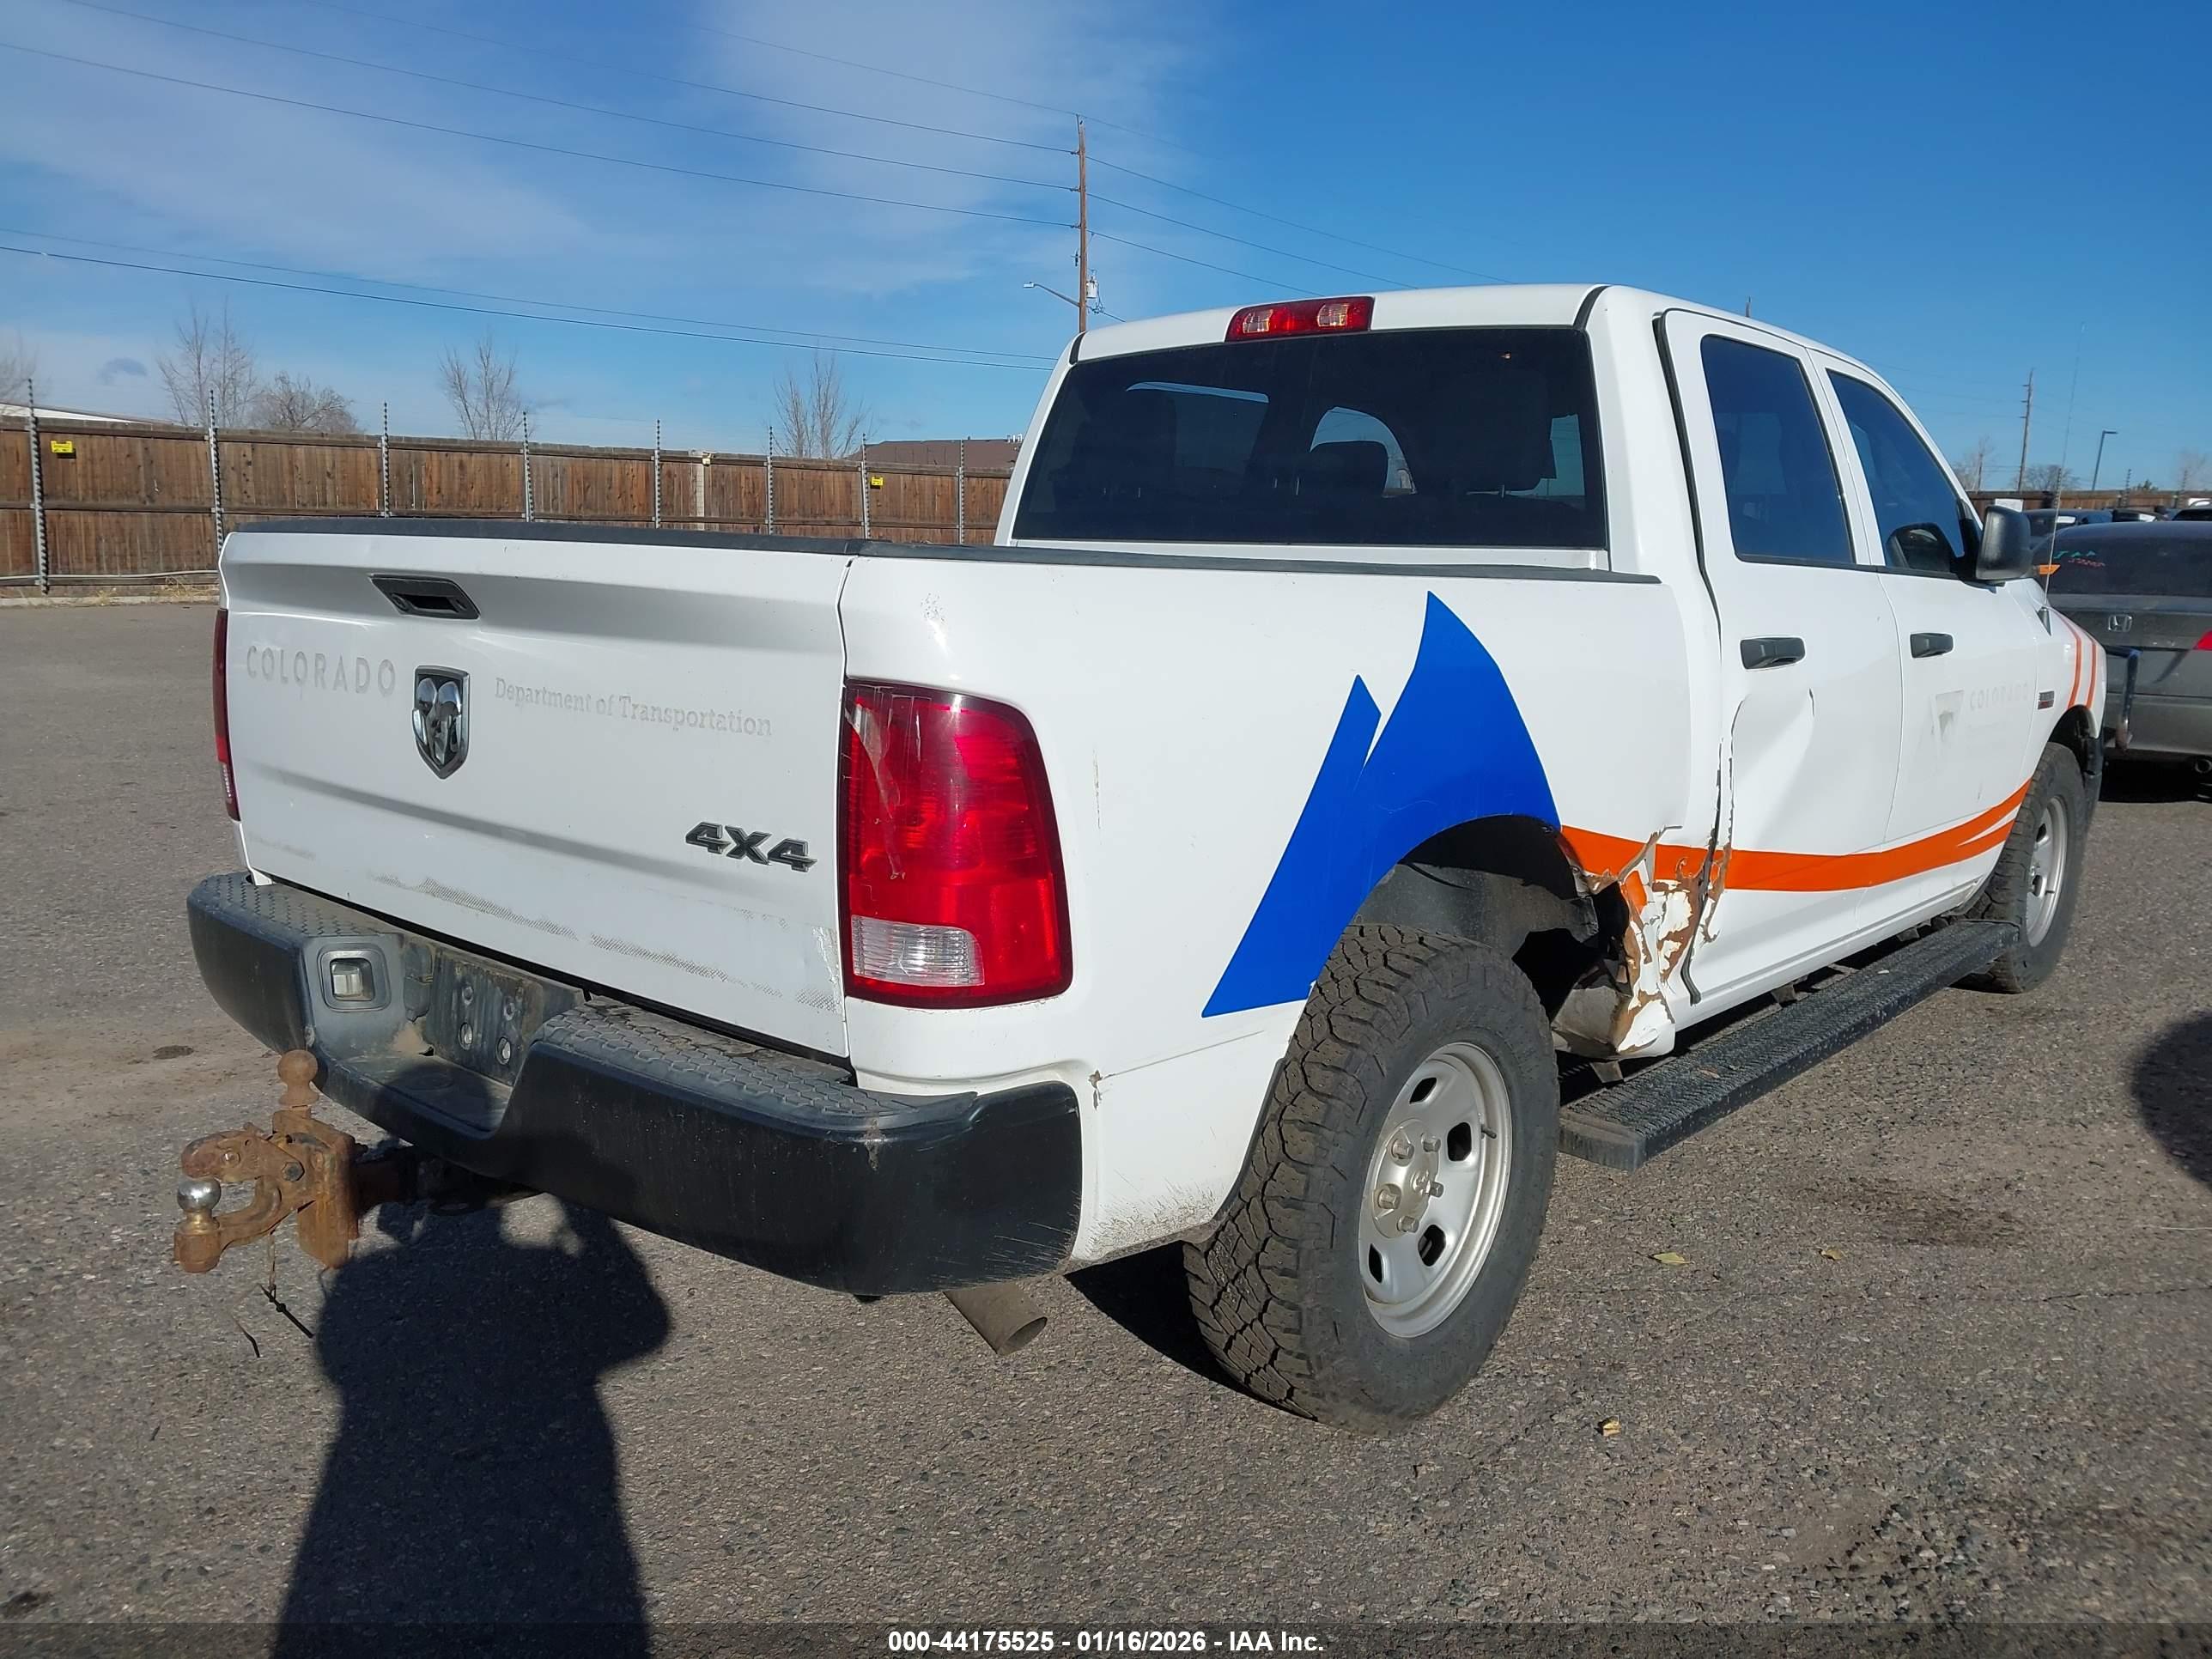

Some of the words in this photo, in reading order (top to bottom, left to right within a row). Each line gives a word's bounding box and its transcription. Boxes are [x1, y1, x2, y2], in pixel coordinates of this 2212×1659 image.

[246, 645, 396, 697] COLORADO
[494, 677, 592, 713] Department
[596, 694, 615, 716] of
[618, 696, 773, 737] Transportation
